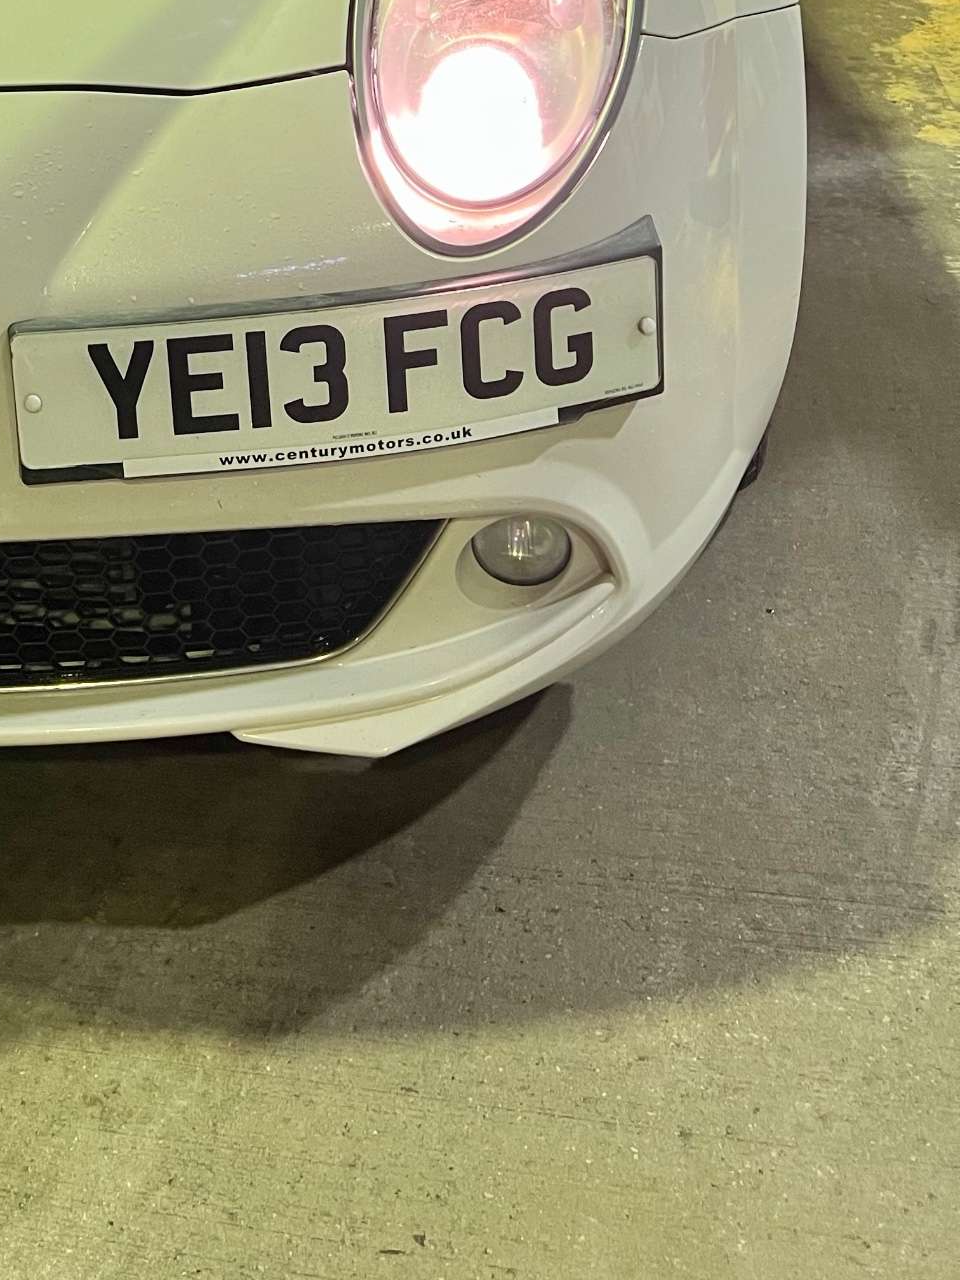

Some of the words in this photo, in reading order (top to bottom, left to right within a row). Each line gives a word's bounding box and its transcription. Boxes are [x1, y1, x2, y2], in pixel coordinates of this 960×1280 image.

[87, 324, 350, 440] YE13
[383, 287, 594, 414] FCG
[219, 425, 473, 468] www.centurymotors.co.uk
